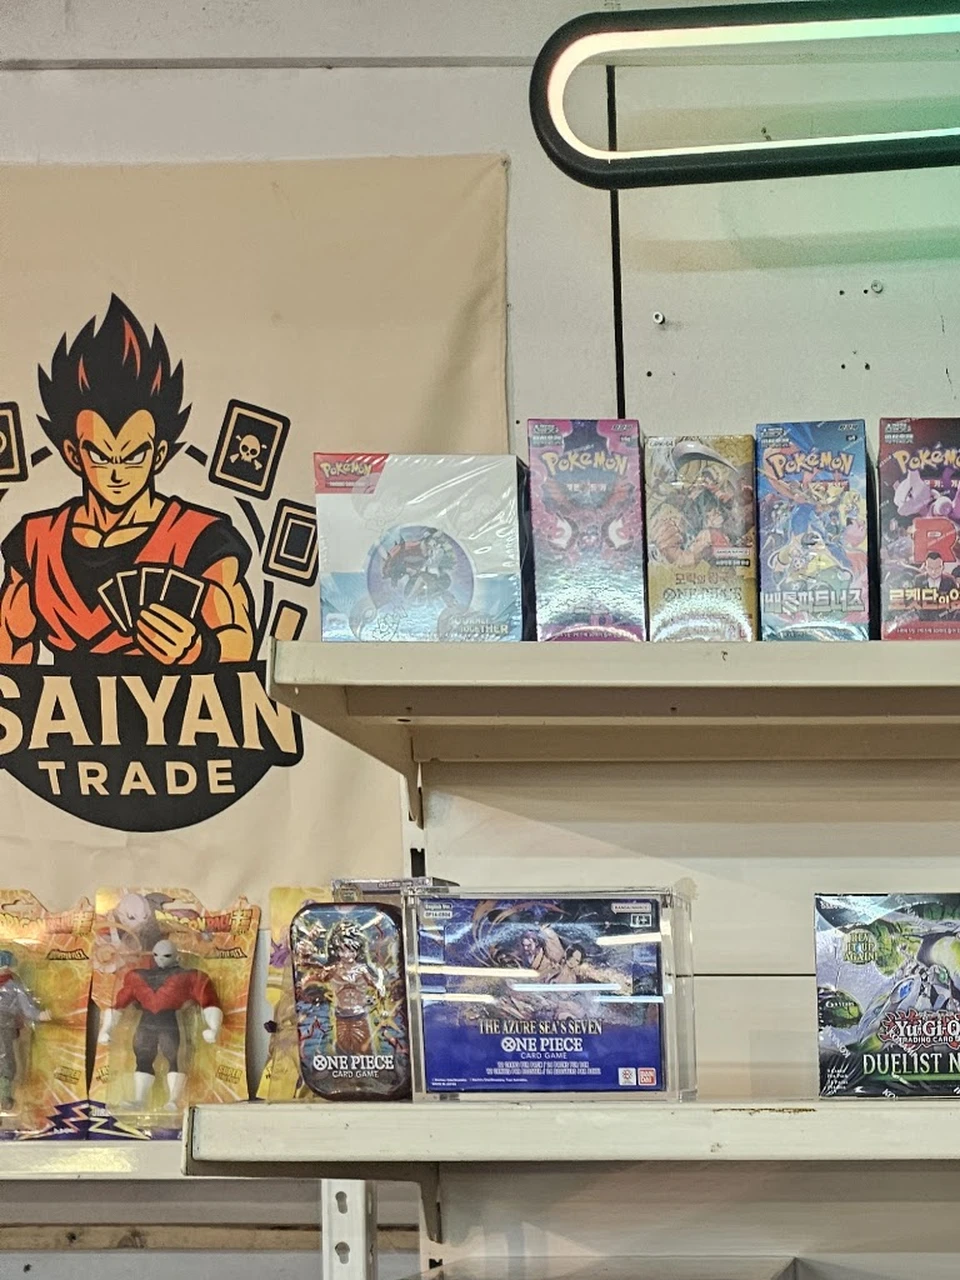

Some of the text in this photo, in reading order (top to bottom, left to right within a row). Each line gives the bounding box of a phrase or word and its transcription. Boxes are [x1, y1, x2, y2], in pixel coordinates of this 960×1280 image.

[38, 759, 236, 796] TRADE
[479, 1019, 501, 1035] THE
[503, 1019, 537, 1035] AZURE
[569, 1019, 602, 1035] SEVEN
[502, 1037, 583, 1052] ONE PIECE
[313, 1054, 394, 1071] ONE PIECE
[863, 1053, 942, 1075] DUELIST
